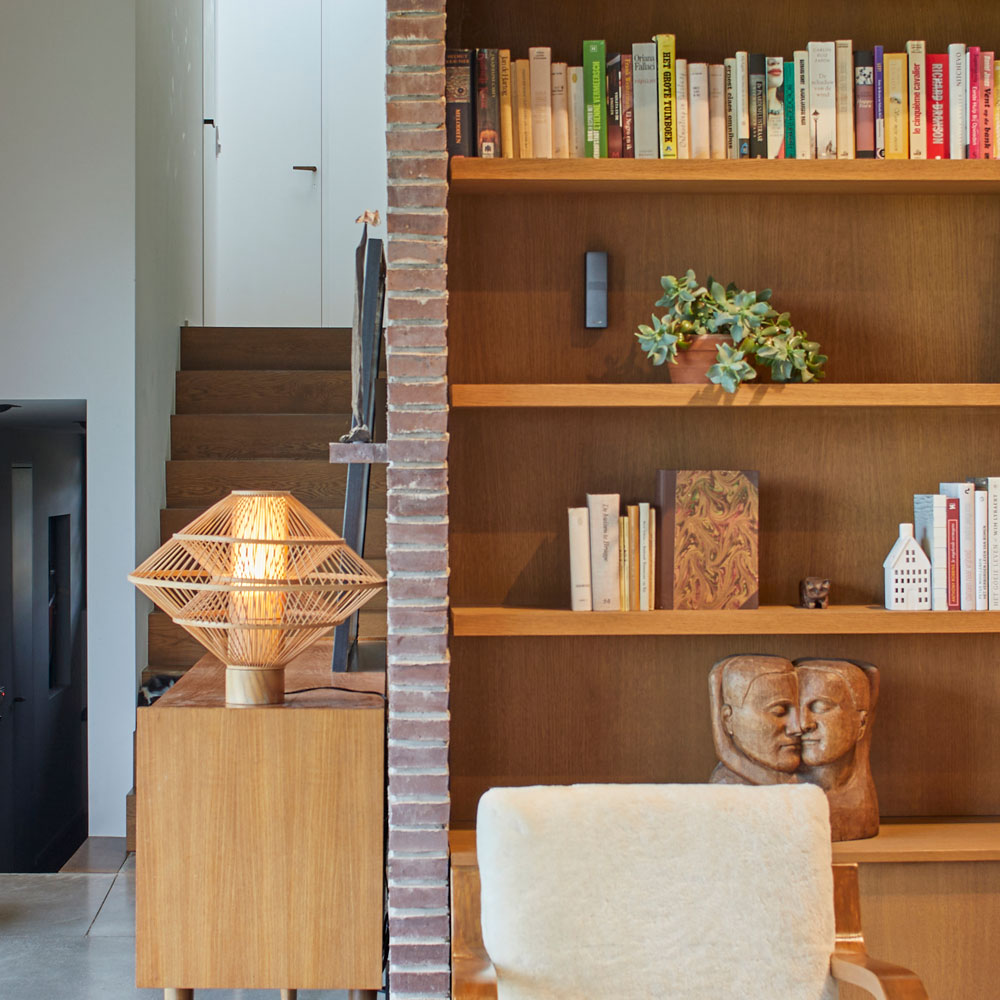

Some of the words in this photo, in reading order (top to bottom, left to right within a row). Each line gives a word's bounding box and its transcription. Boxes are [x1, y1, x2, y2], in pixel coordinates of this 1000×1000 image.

[500, 56, 508, 66] Jan
[633, 54, 655, 62] Oriana
[633, 62, 655, 71] Fallaci
[663, 52, 671, 69] HET
[501, 73, 509, 96] Hartog
[663, 71, 671, 99] GROTE
[913, 62, 921, 91] cavalier
[931, 63, 944, 101] RICHARD
[912, 91, 922, 127] cinquième
[971, 114, 979, 122] Bij
[983, 109, 989, 117] op
[663, 100, 672, 143] TUINBOEK
[931, 102, 944, 144] BRANSON
[984, 117, 989, 125] de
